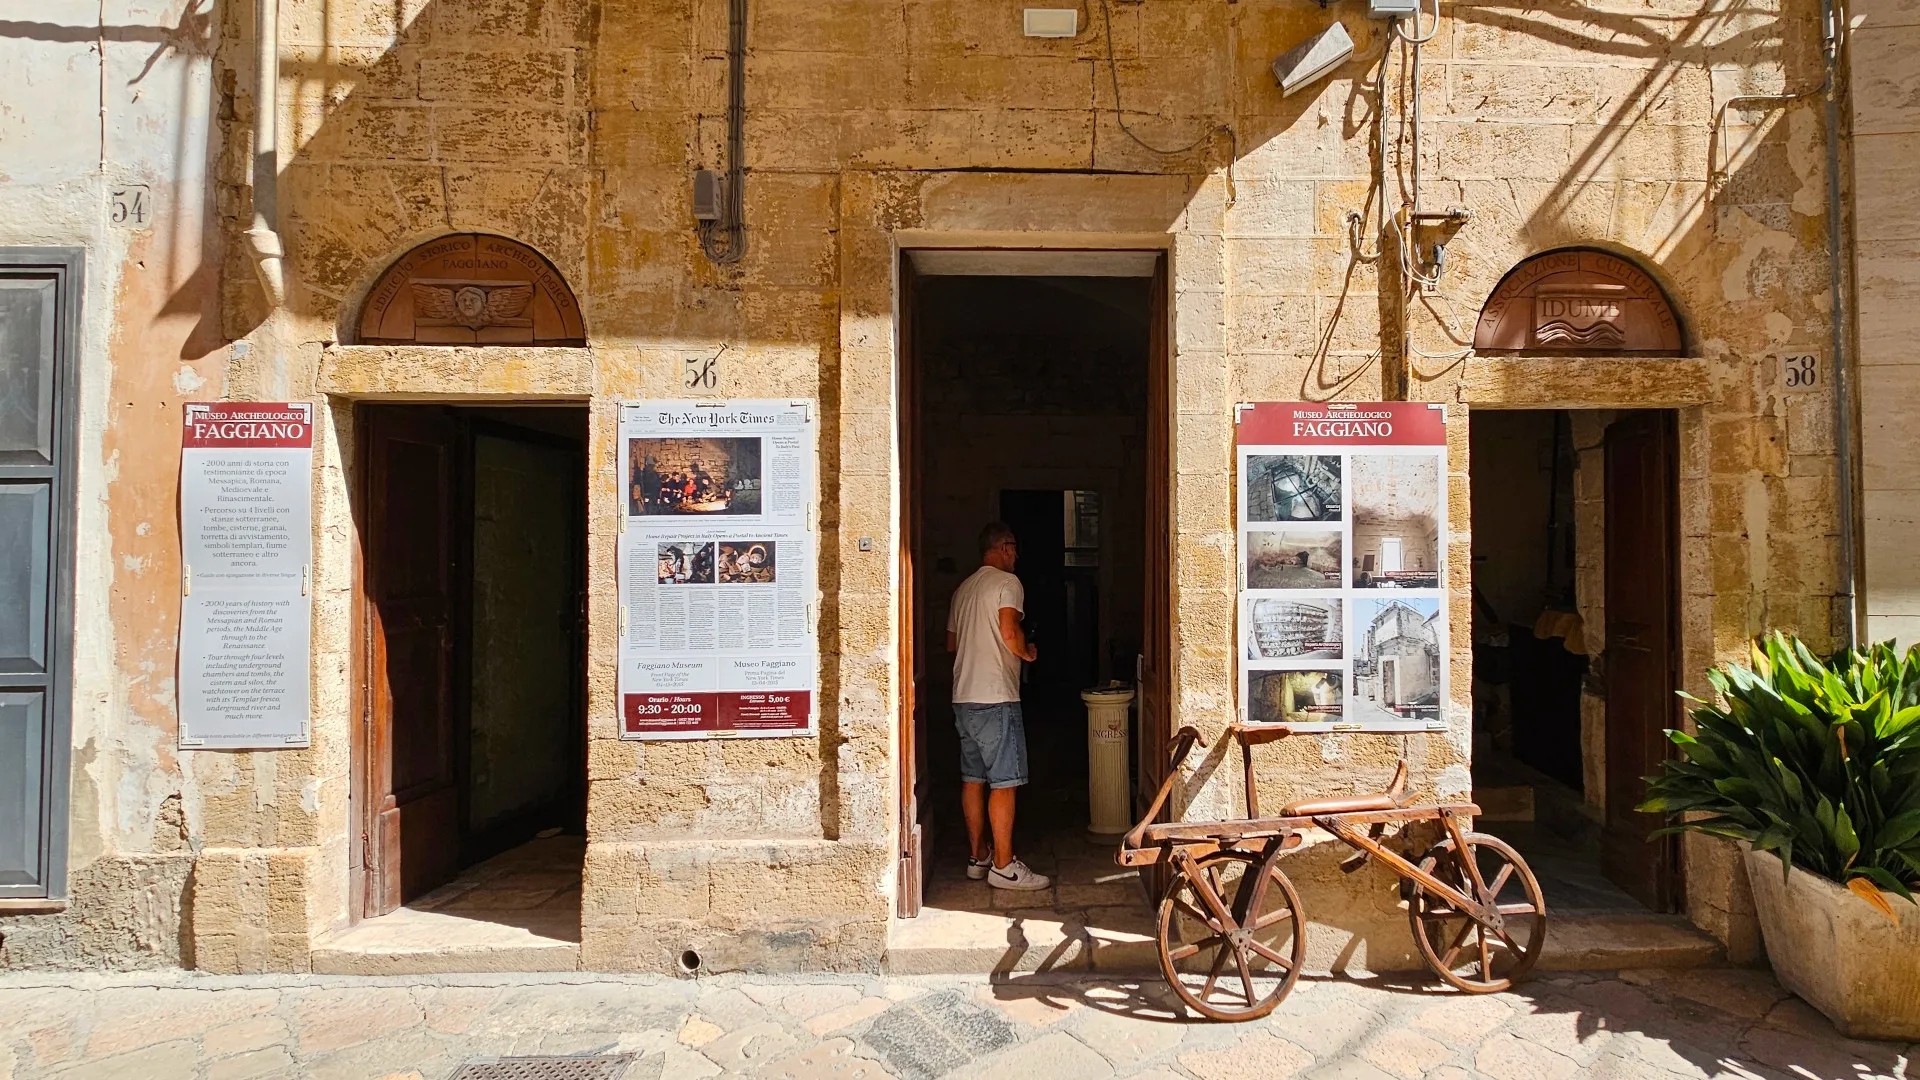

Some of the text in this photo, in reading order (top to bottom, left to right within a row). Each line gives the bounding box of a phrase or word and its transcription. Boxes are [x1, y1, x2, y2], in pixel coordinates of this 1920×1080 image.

[113, 191, 146, 223] 54
[443, 259, 508, 269] FAGGIANO
[374, 241, 570, 313] EDIFICIO STORICO ARCHEOLOGICO
[1484, 256, 1673, 329] ASSOCIAZIONE CULTURALE
[1542, 301, 1620, 317] IDUME
[685, 358, 717, 389] 56
[1785, 355, 1815, 387] 58
[195, 412, 303, 420] MUSEO ARCHEOLOGICO
[1293, 410, 1392, 419] MUSEO ARCHEOLOGICO
[658, 412, 681, 426] The
[682, 413, 707, 426] New
[710, 413, 737, 427] York
[739, 413, 775, 425] Times
[194, 423, 303, 439] FAGGIANO
[1293, 422, 1392, 437] FAGGIANO
[232, 542, 265, 550] templari,
[244, 600, 251, 608] of
[251, 600, 274, 608] history
[222, 634, 248, 642] through
[224, 654, 250, 662] through
[251, 654, 265, 662] four
[206, 662, 282, 670] including underground
[637, 662, 670, 670] Faggiano
[761, 660, 796, 668] Faggiano
[232, 696, 259, 704] Templar
[260, 696, 280, 704] fresco,
[768, 695, 784, 703] 5,00
[638, 705, 661, 714] 9:30
[671, 704, 701, 714] 20:00
